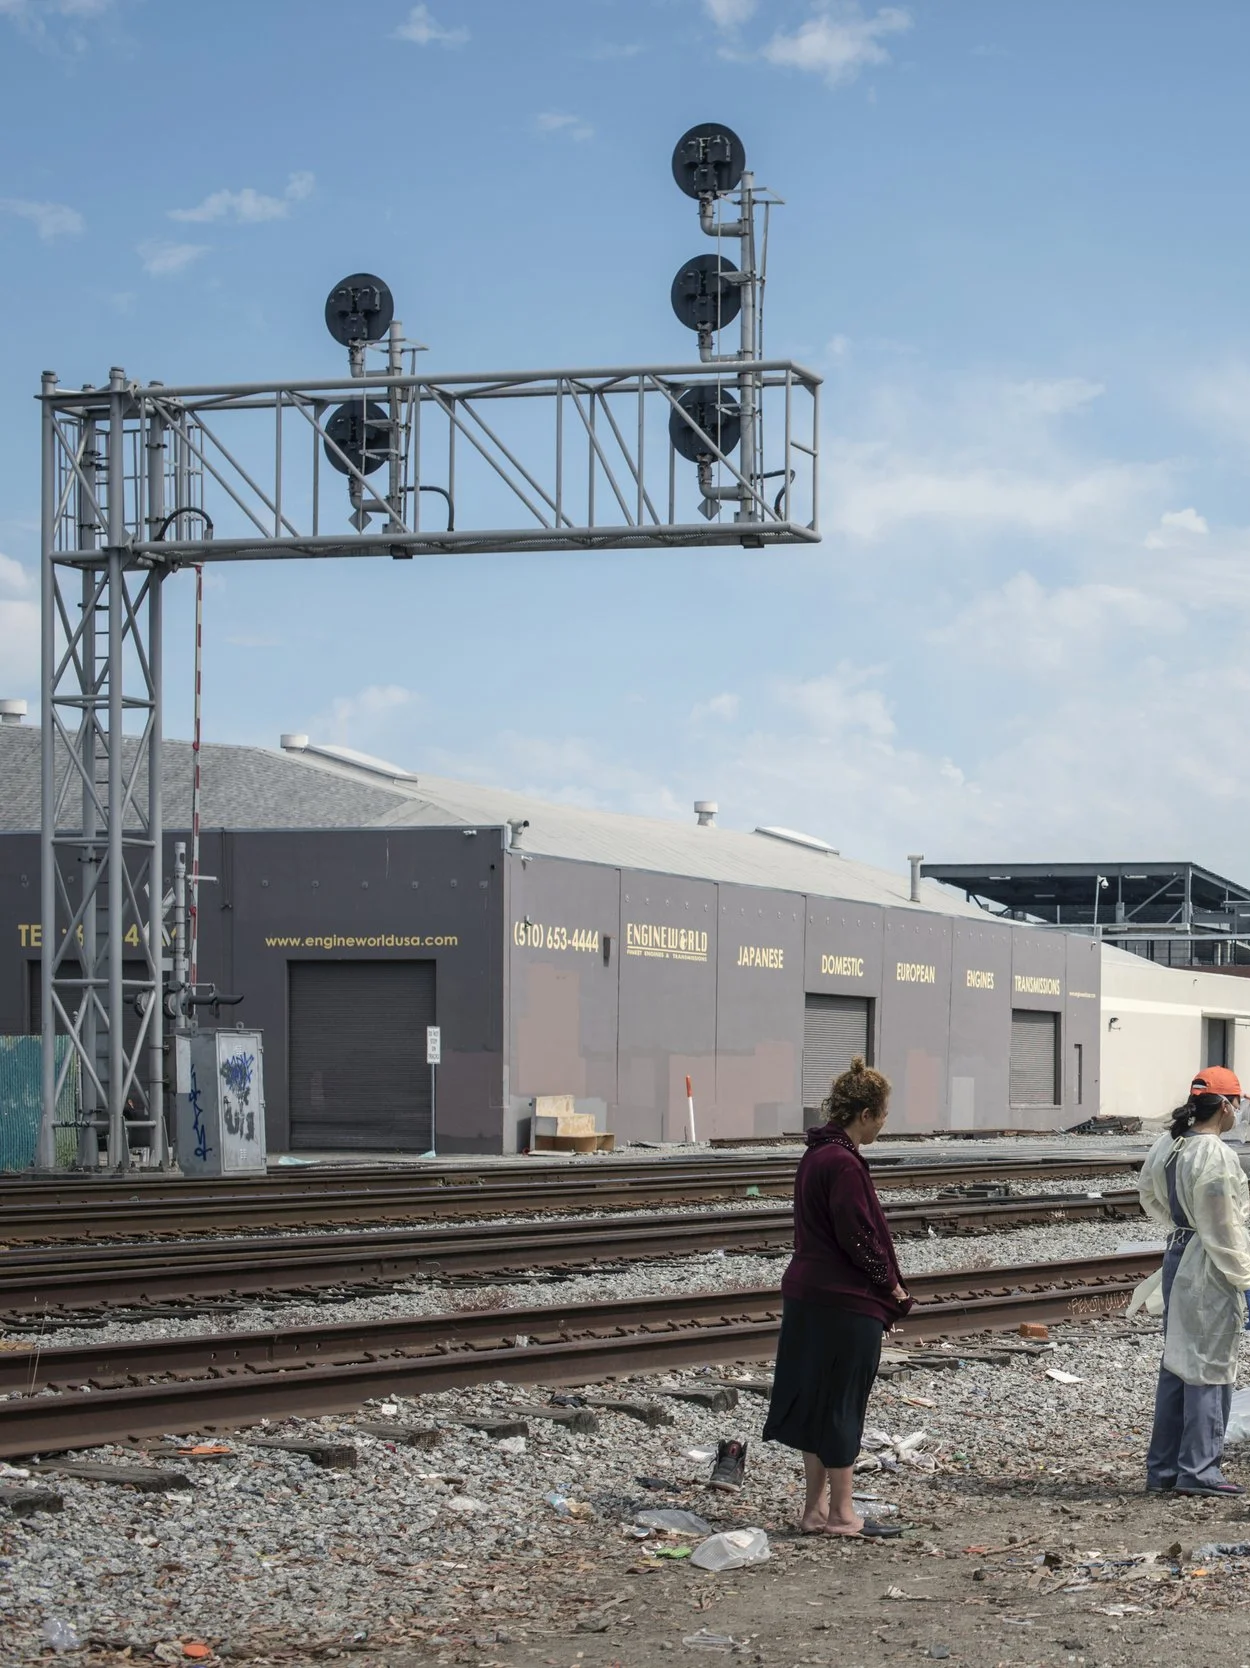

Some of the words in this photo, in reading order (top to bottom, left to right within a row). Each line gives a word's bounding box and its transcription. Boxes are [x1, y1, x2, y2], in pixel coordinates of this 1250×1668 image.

[18, 924, 43, 947] TE
[265, 934, 458, 949] www.engineworldusa.com
[514, 922, 544, 948] (510)
[546, 926, 599, 953] 653-4444
[627, 923, 708, 952] ENGINEWORLD
[737, 945, 784, 969] JAPANESE
[821, 954, 864, 977] DOMESTIC
[896, 962, 936, 984] EUROPEAN
[966, 970, 995, 989] ENGINES
[1014, 975, 1060, 996] TRANSMISSIONS
